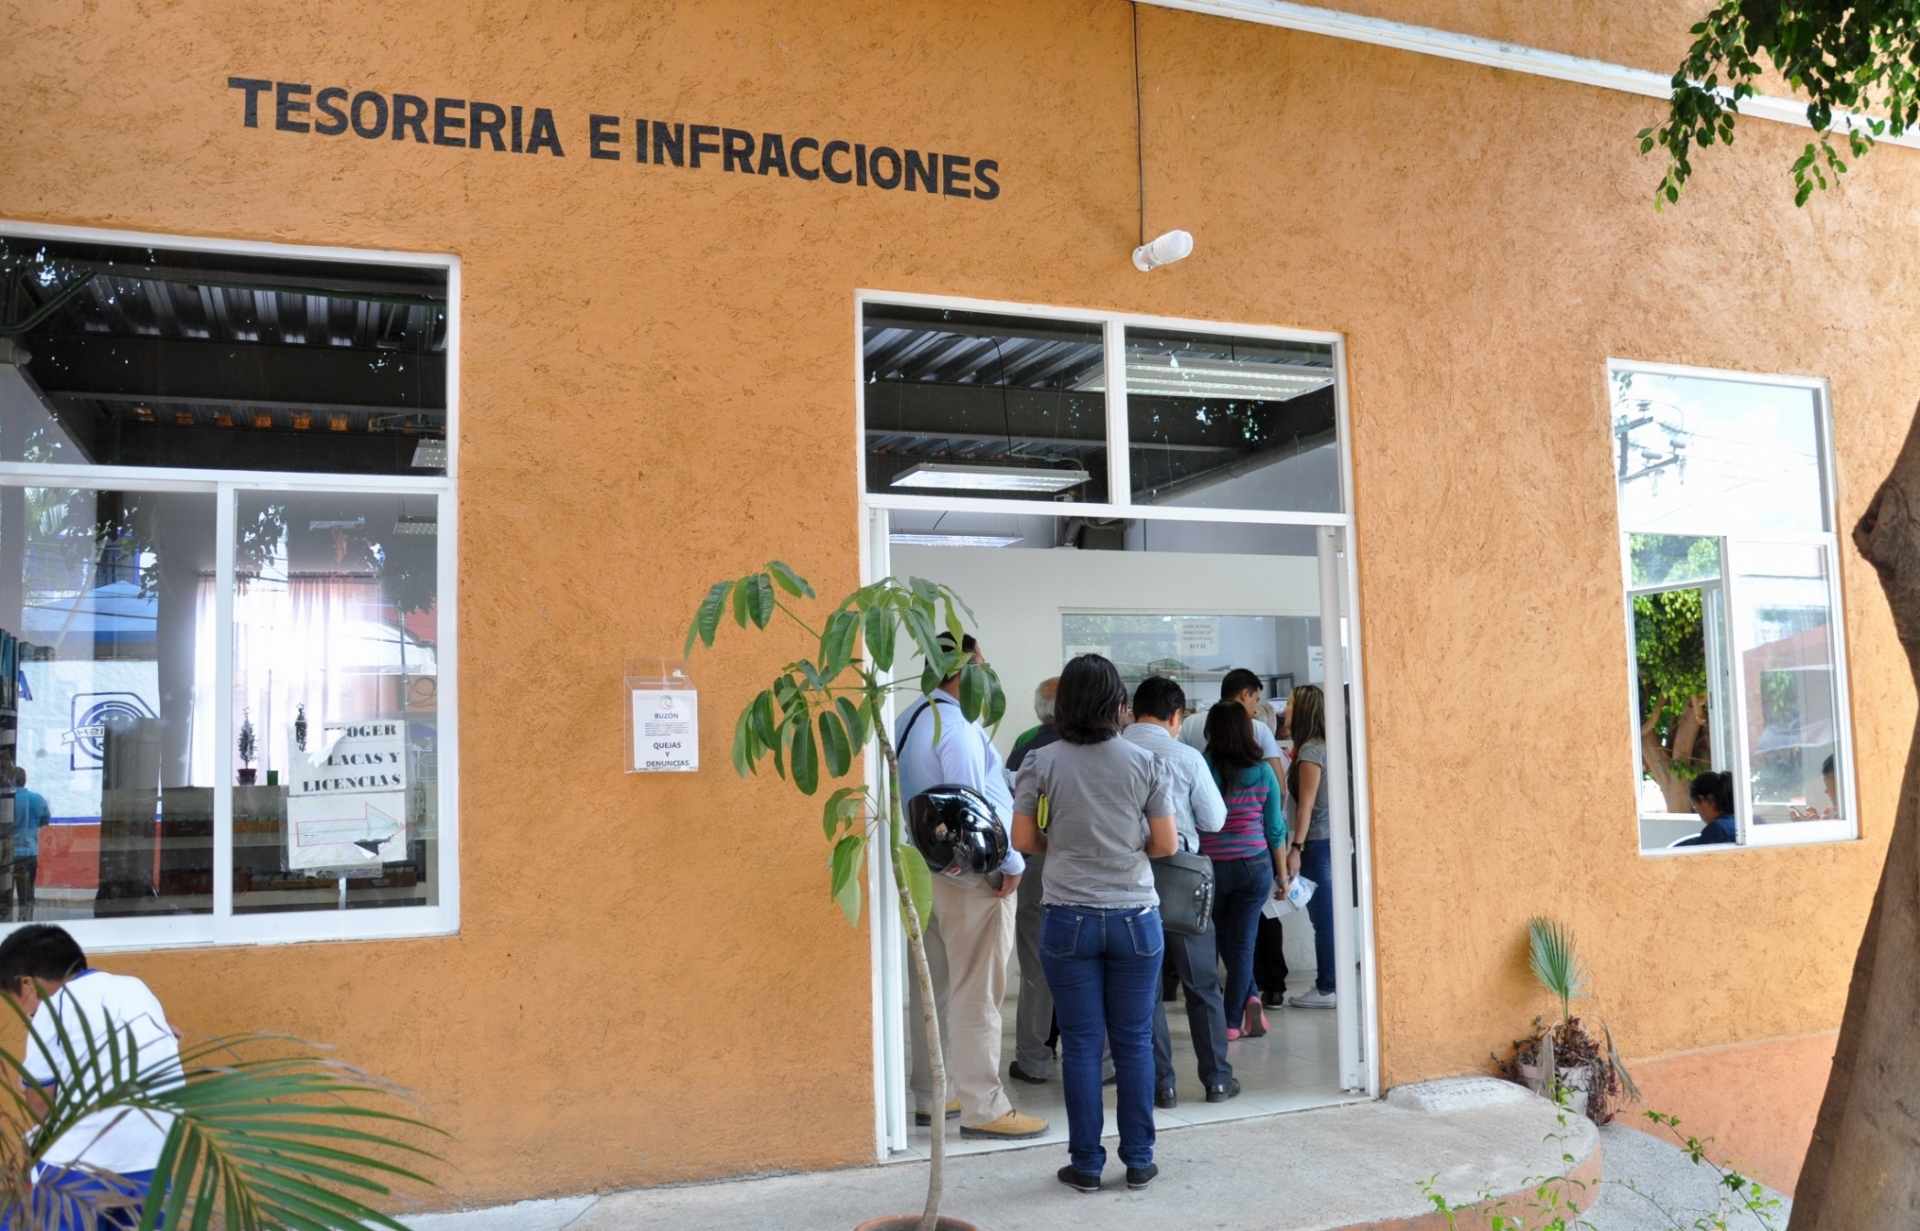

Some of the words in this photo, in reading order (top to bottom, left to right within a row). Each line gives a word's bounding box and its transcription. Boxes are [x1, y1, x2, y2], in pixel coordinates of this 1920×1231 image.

[227, 77, 565, 157] TESORERIA
[589, 114, 620, 161] E
[636, 118, 1001, 201] INFRACCIONES
[654, 711, 679, 719] BUZÓN
[653, 742, 682, 750] QUEJAS
[327, 753, 383, 766] LACAS
[389, 752, 400, 763] Y
[303, 774, 401, 792] LICENCIAS
